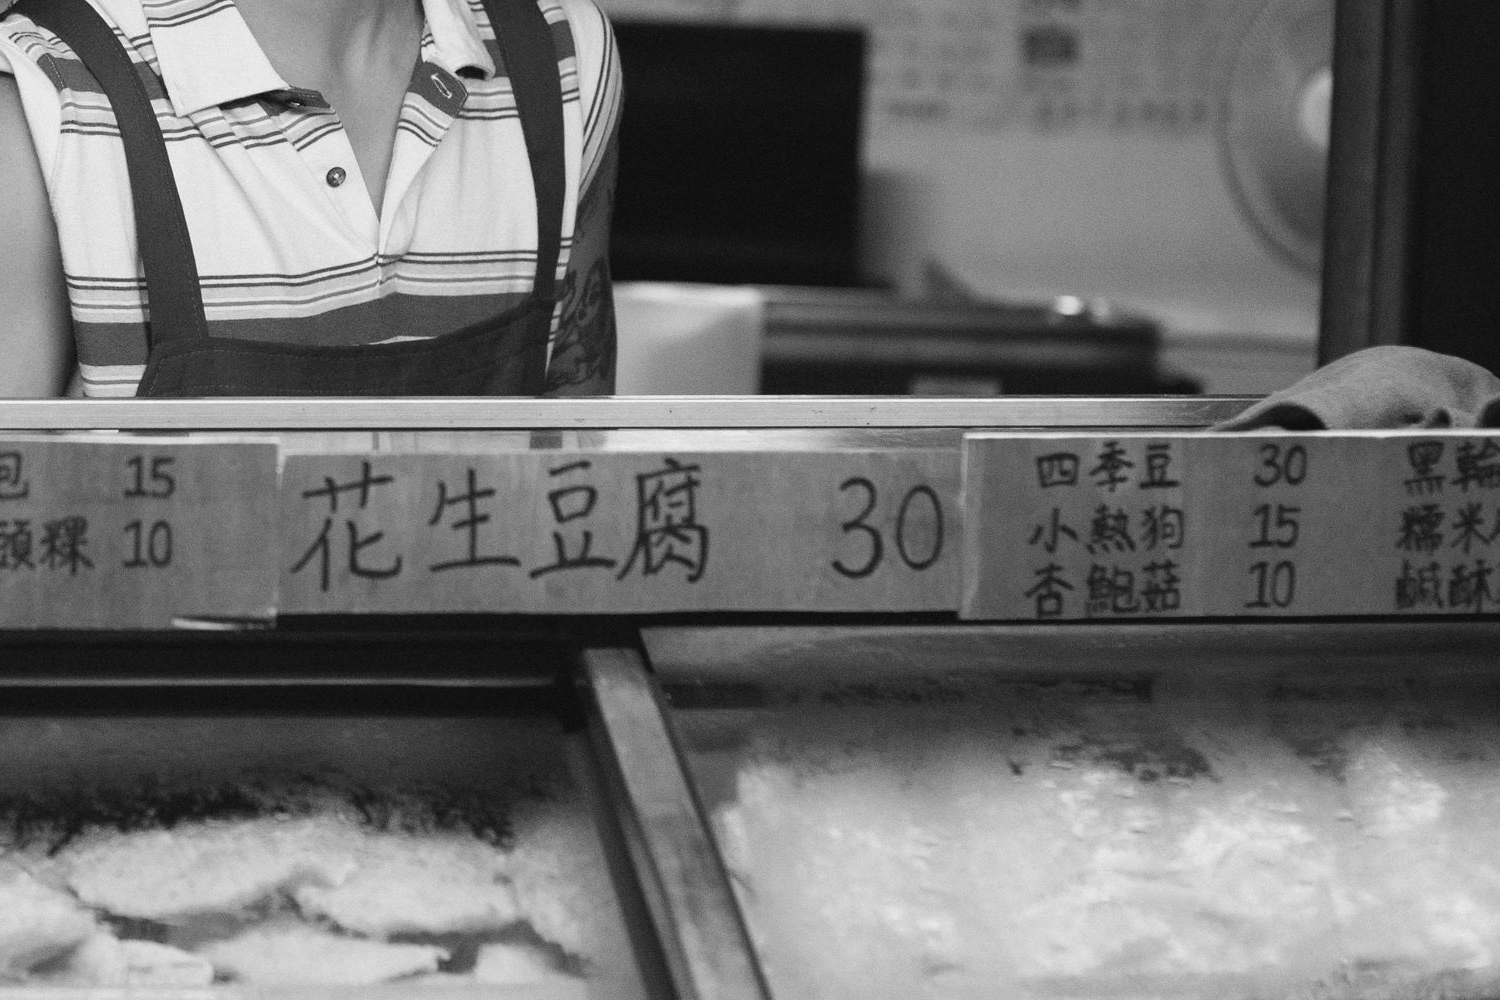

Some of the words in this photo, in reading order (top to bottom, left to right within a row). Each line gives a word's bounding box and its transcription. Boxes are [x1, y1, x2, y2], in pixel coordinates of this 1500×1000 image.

[124, 455, 176, 498] 15
[1036, 441, 1180, 492] 四季豆
[1254, 443, 1308, 486] 30
[122, 520, 173, 568] 10
[290, 458, 708, 591] 花生豆腐
[832, 477, 944, 578] 30
[1028, 505, 1184, 554] 小熱狗
[1249, 504, 1298, 548] 15
[1397, 504, 1500, 554] 糯米
[1025, 560, 1181, 618] 杏鮑菇
[1246, 562, 1295, 608] 10
[1396, 560, 1500, 613] 鹹酥
